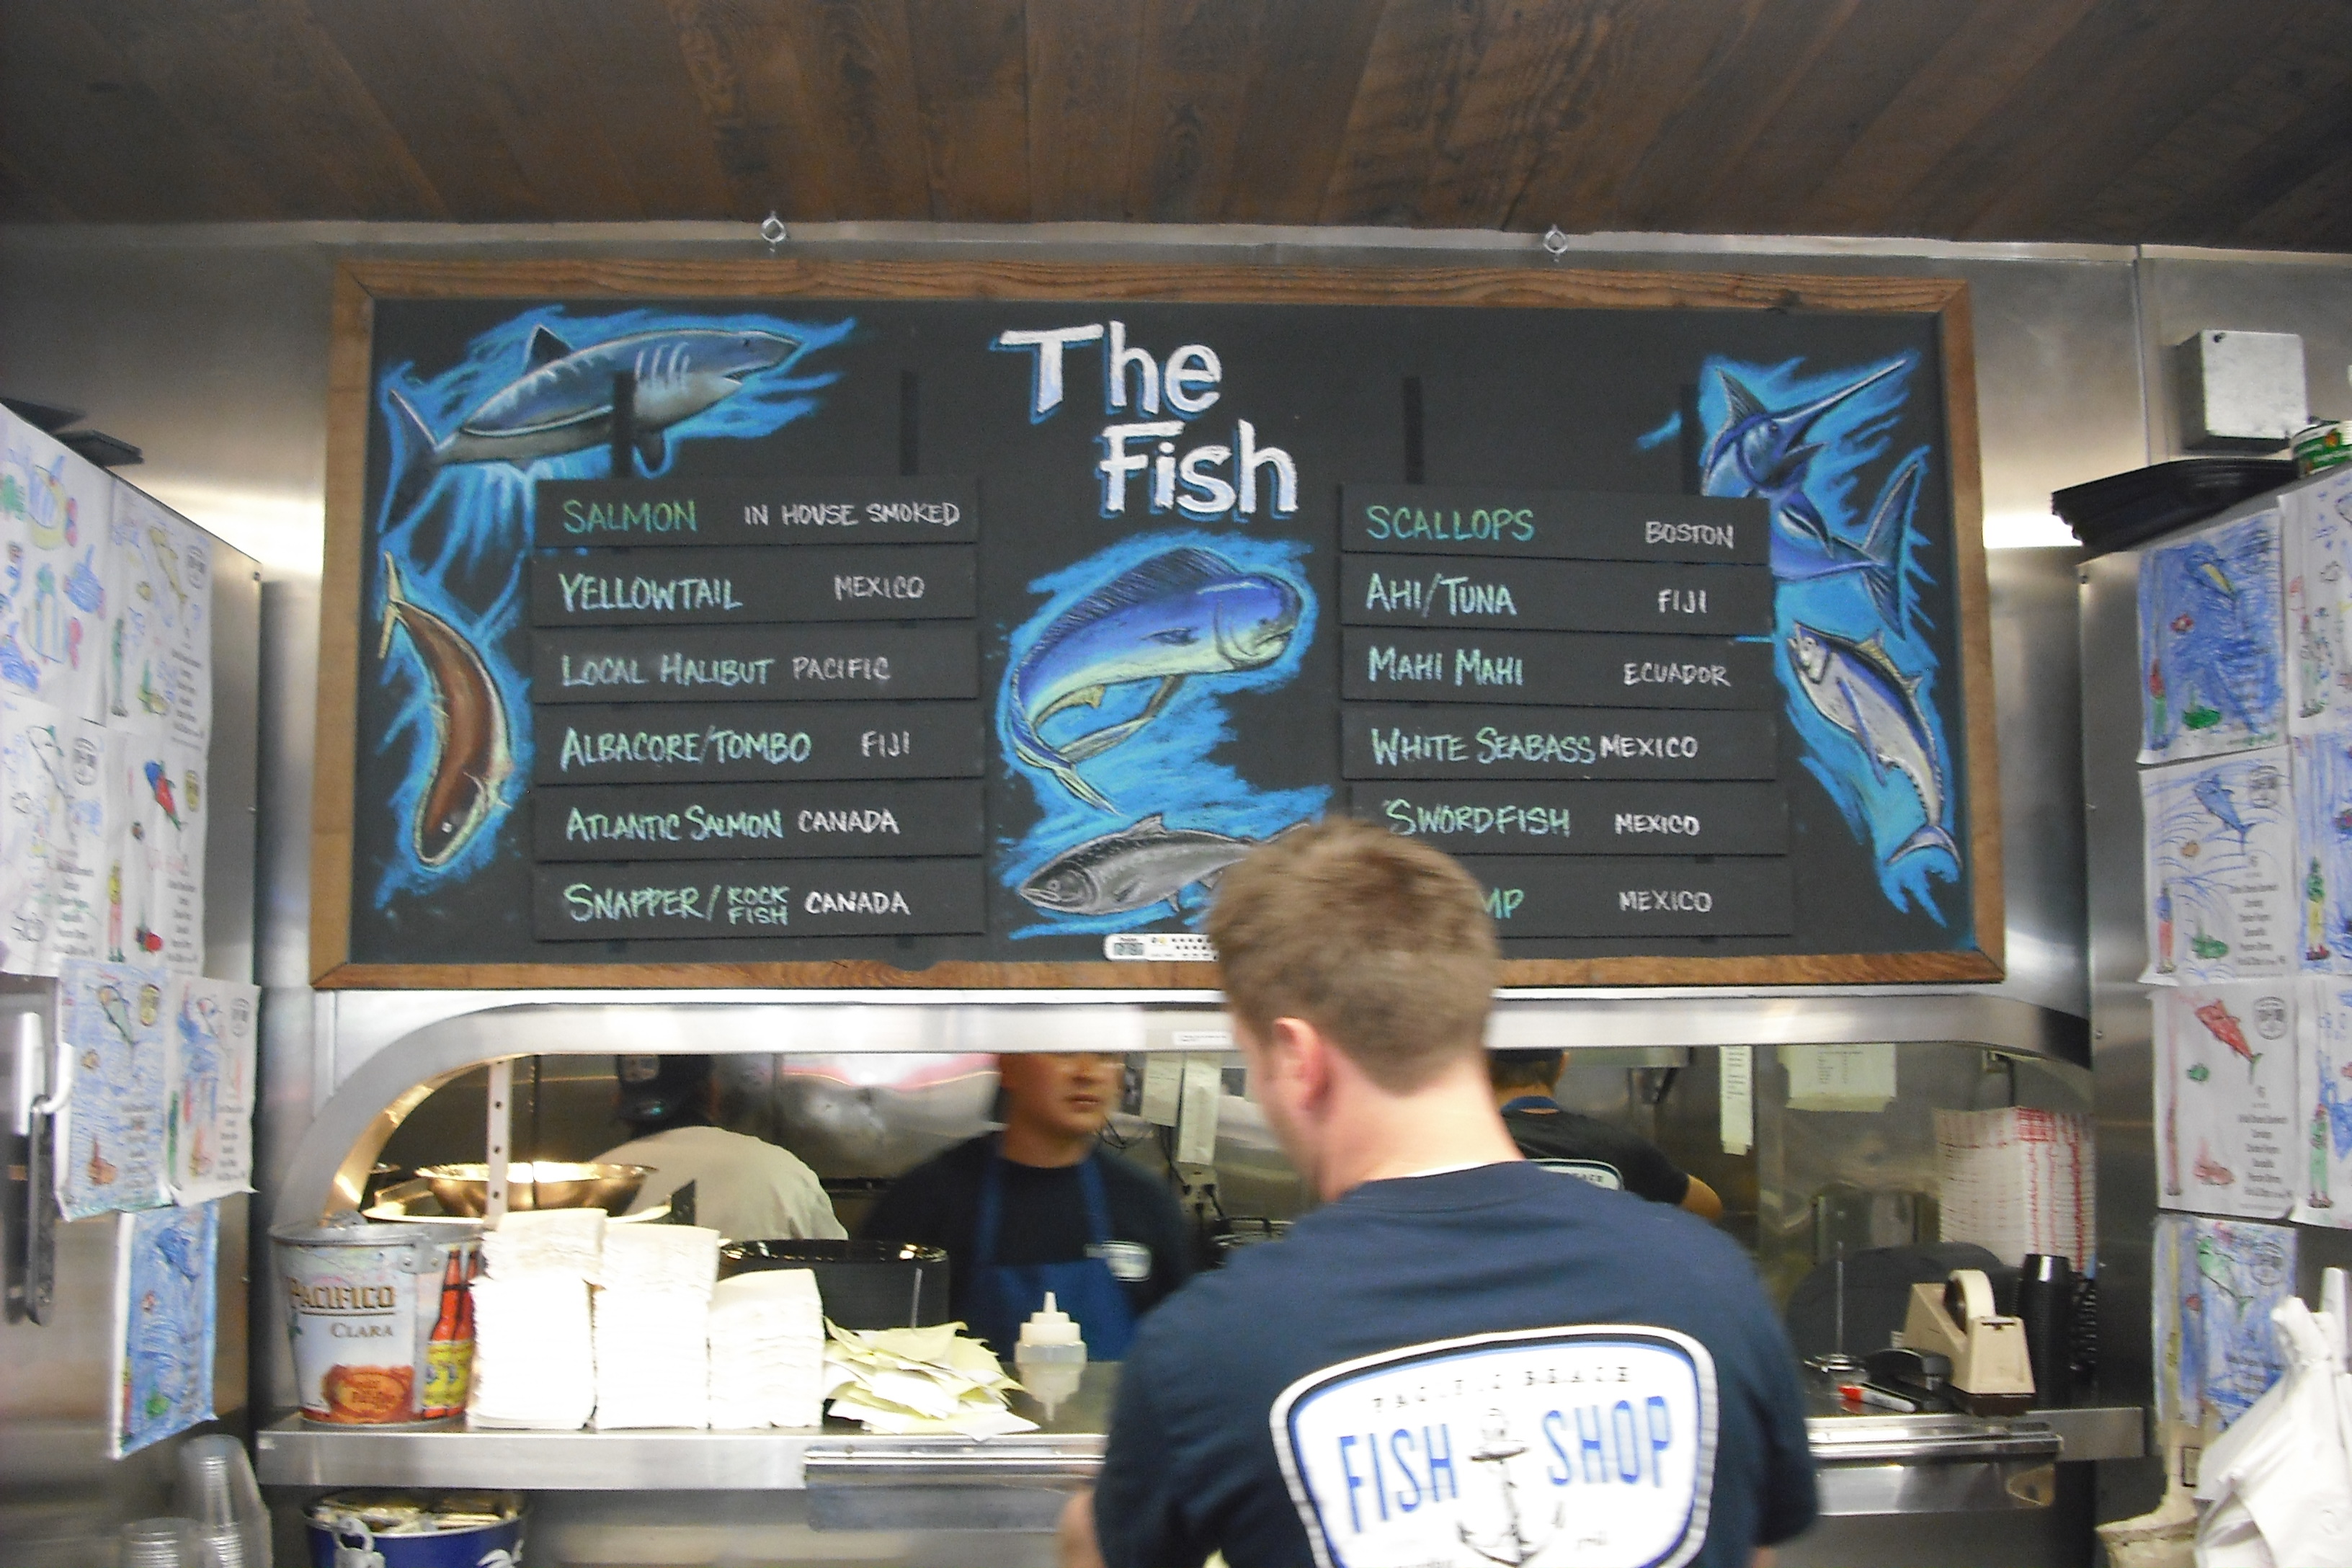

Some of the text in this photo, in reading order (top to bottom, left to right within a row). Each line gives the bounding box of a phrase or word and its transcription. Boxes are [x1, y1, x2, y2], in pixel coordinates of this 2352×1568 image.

[999, 320, 1221, 414] The
[1100, 419, 1298, 513] Fish
[563, 499, 961, 534] SALMON IN HOUSE SMOKED
[1366, 505, 1734, 549] SCALLOPS BOSTON
[558, 573, 925, 612] YELLOWTAIL MEXICO
[1657, 589, 1706, 614] FIJI
[562, 652, 891, 687] LOCAL HALIBUT PACIFIC
[1368, 646, 1731, 687] MAHI MAHI ECUADOR
[861, 731, 909, 757] FIJI
[1371, 726, 1698, 766] WHITE SEABASS MEXICO
[566, 804, 900, 842] ATLANTIC SALMON CANADA
[1384, 798, 1701, 837] SWORDFISH MEXICO
[727, 886, 790, 906] ROCK
[804, 891, 910, 915] CANADA
[1619, 890, 1712, 912] MEXICO
[727, 905, 788, 926] FISH
[1338, 1396, 1673, 1533] FISH SHOP
